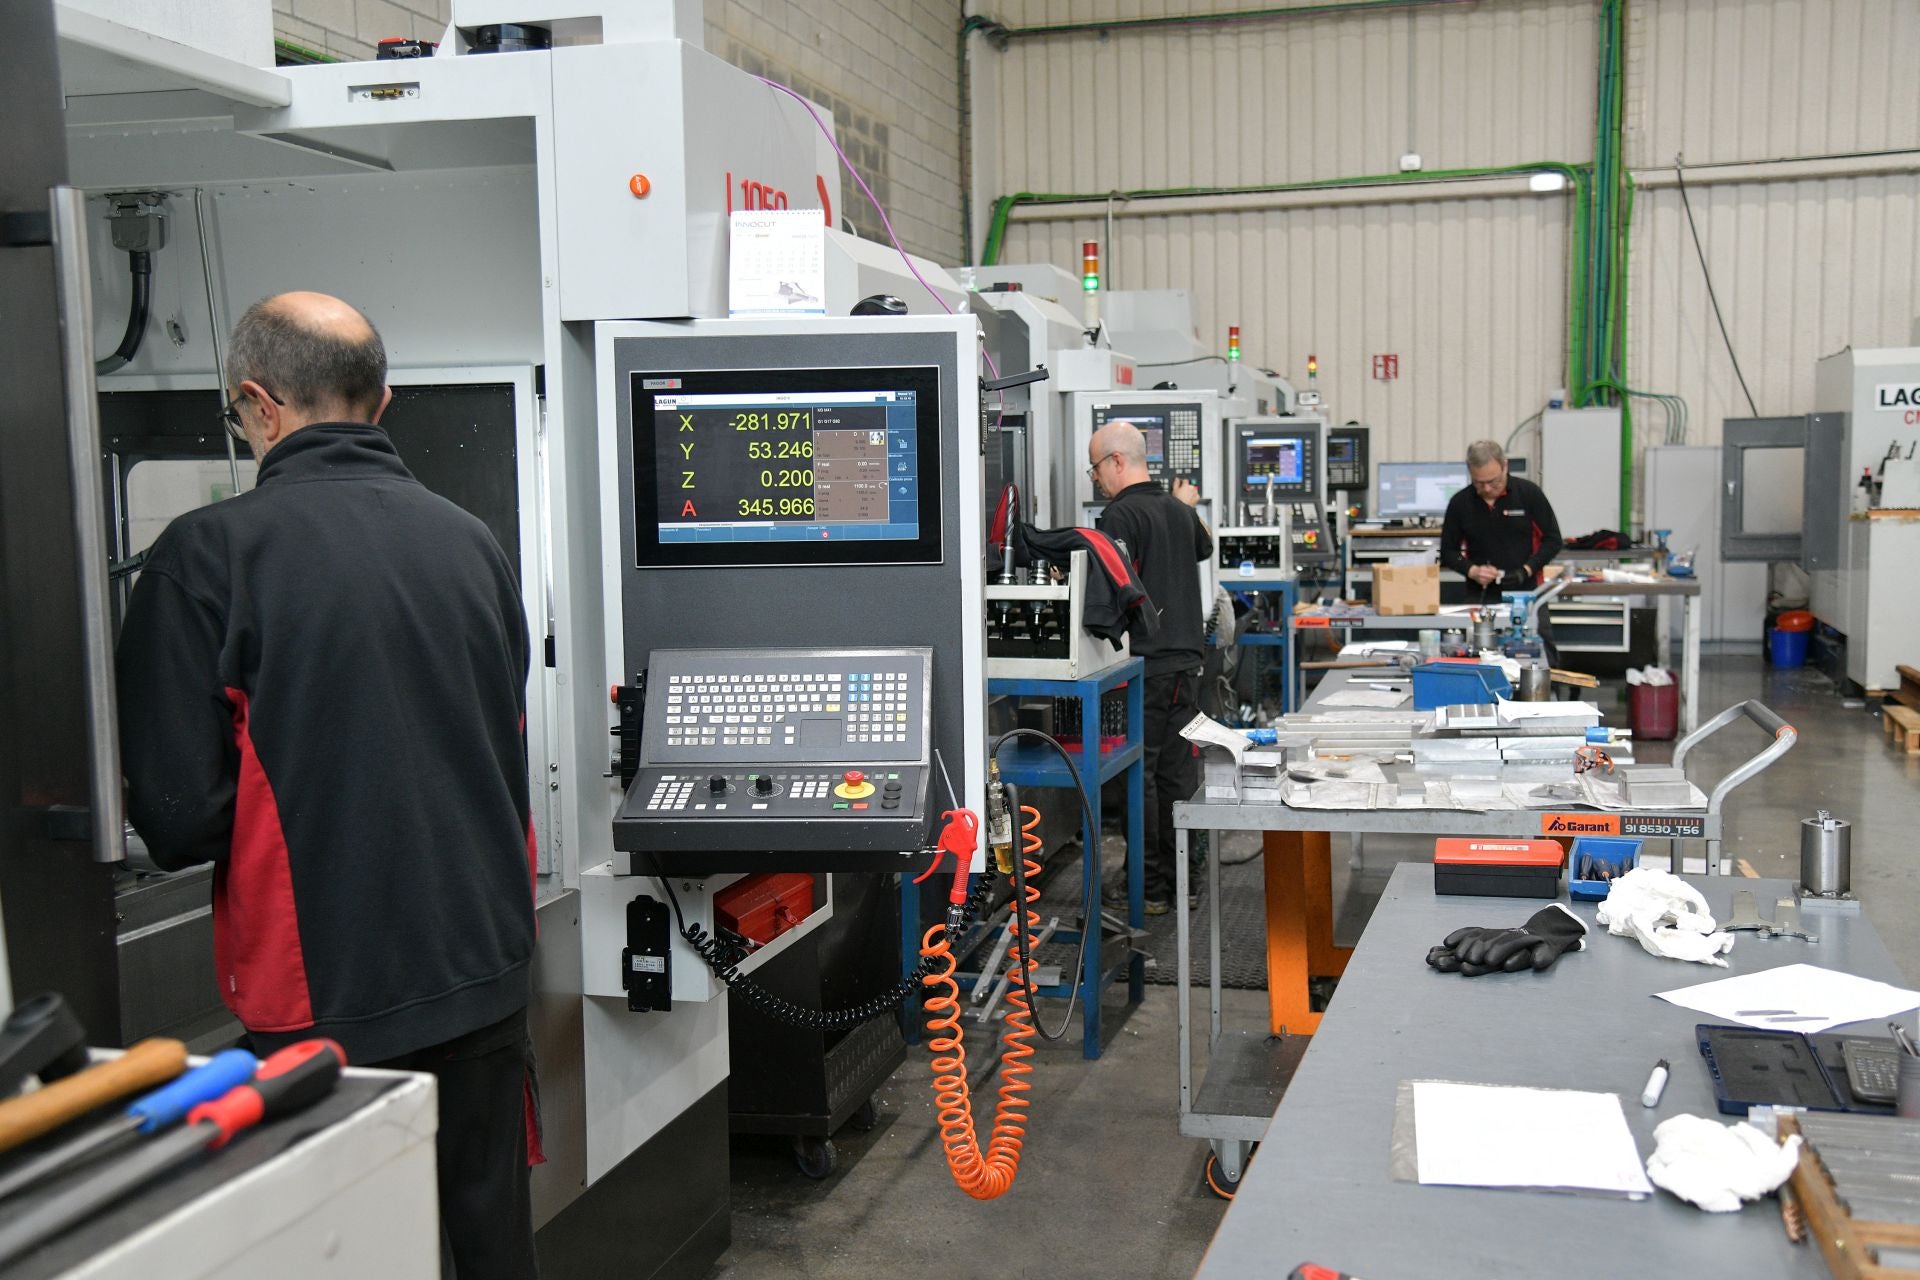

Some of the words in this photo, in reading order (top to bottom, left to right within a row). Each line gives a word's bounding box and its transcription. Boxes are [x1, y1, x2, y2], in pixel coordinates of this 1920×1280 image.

[680, 414, 694, 432] X
[729, 413, 811, 430] -281.971
[680, 443, 694, 460] Y
[748, 442, 812, 459] 53.246
[682, 472, 696, 489] Z
[761, 470, 813, 487] 0.200
[682, 500, 696, 517] A
[738, 499, 814, 516] 345.966
[1568, 822, 1610, 832] Garant
